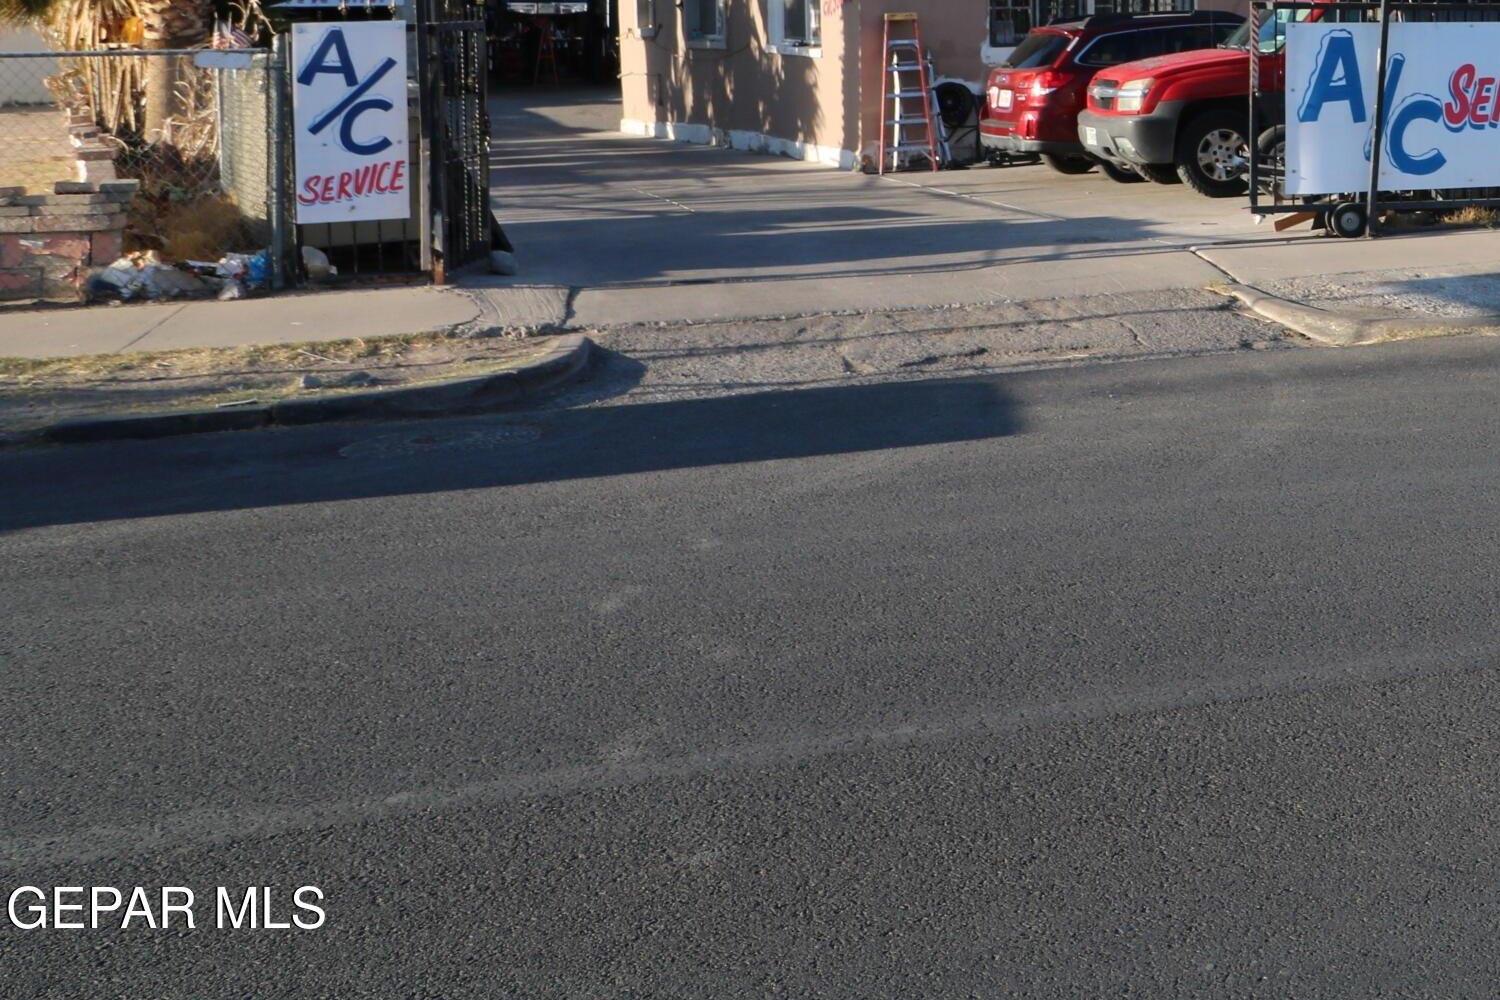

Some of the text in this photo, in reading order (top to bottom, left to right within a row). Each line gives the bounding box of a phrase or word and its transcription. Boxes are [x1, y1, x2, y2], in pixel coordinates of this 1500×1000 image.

[297, 27, 398, 156] A/C
[1297, 29, 1447, 176] A/C
[298, 160, 406, 206] SERVICE
